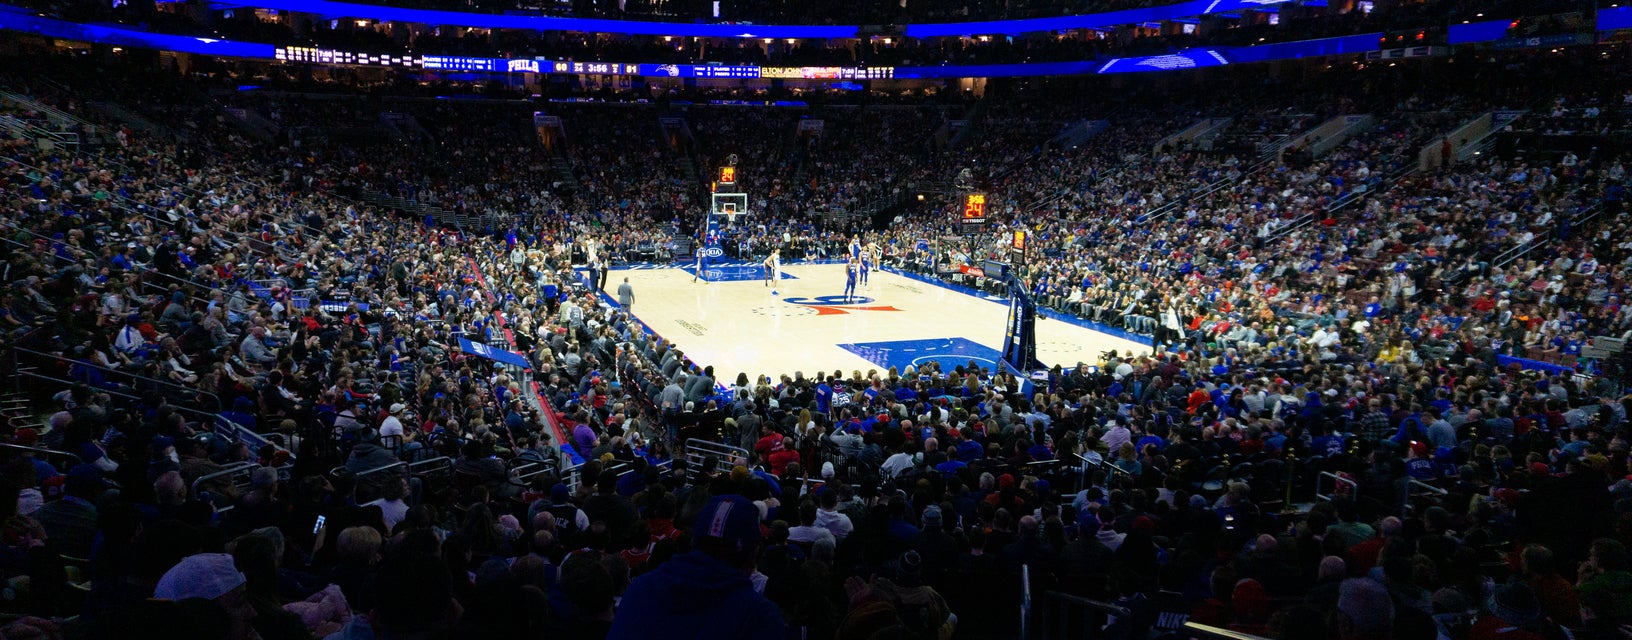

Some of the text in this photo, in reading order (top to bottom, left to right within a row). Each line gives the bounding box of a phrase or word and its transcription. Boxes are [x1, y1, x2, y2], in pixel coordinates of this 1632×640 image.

[507, 60, 539, 73] PHILA
[555, 63, 567, 71] 60
[588, 64, 608, 72] 3:56
[965, 203, 982, 217] 24
[838, 396, 850, 405] 25
[1156, 611, 1191, 629] NIKE
